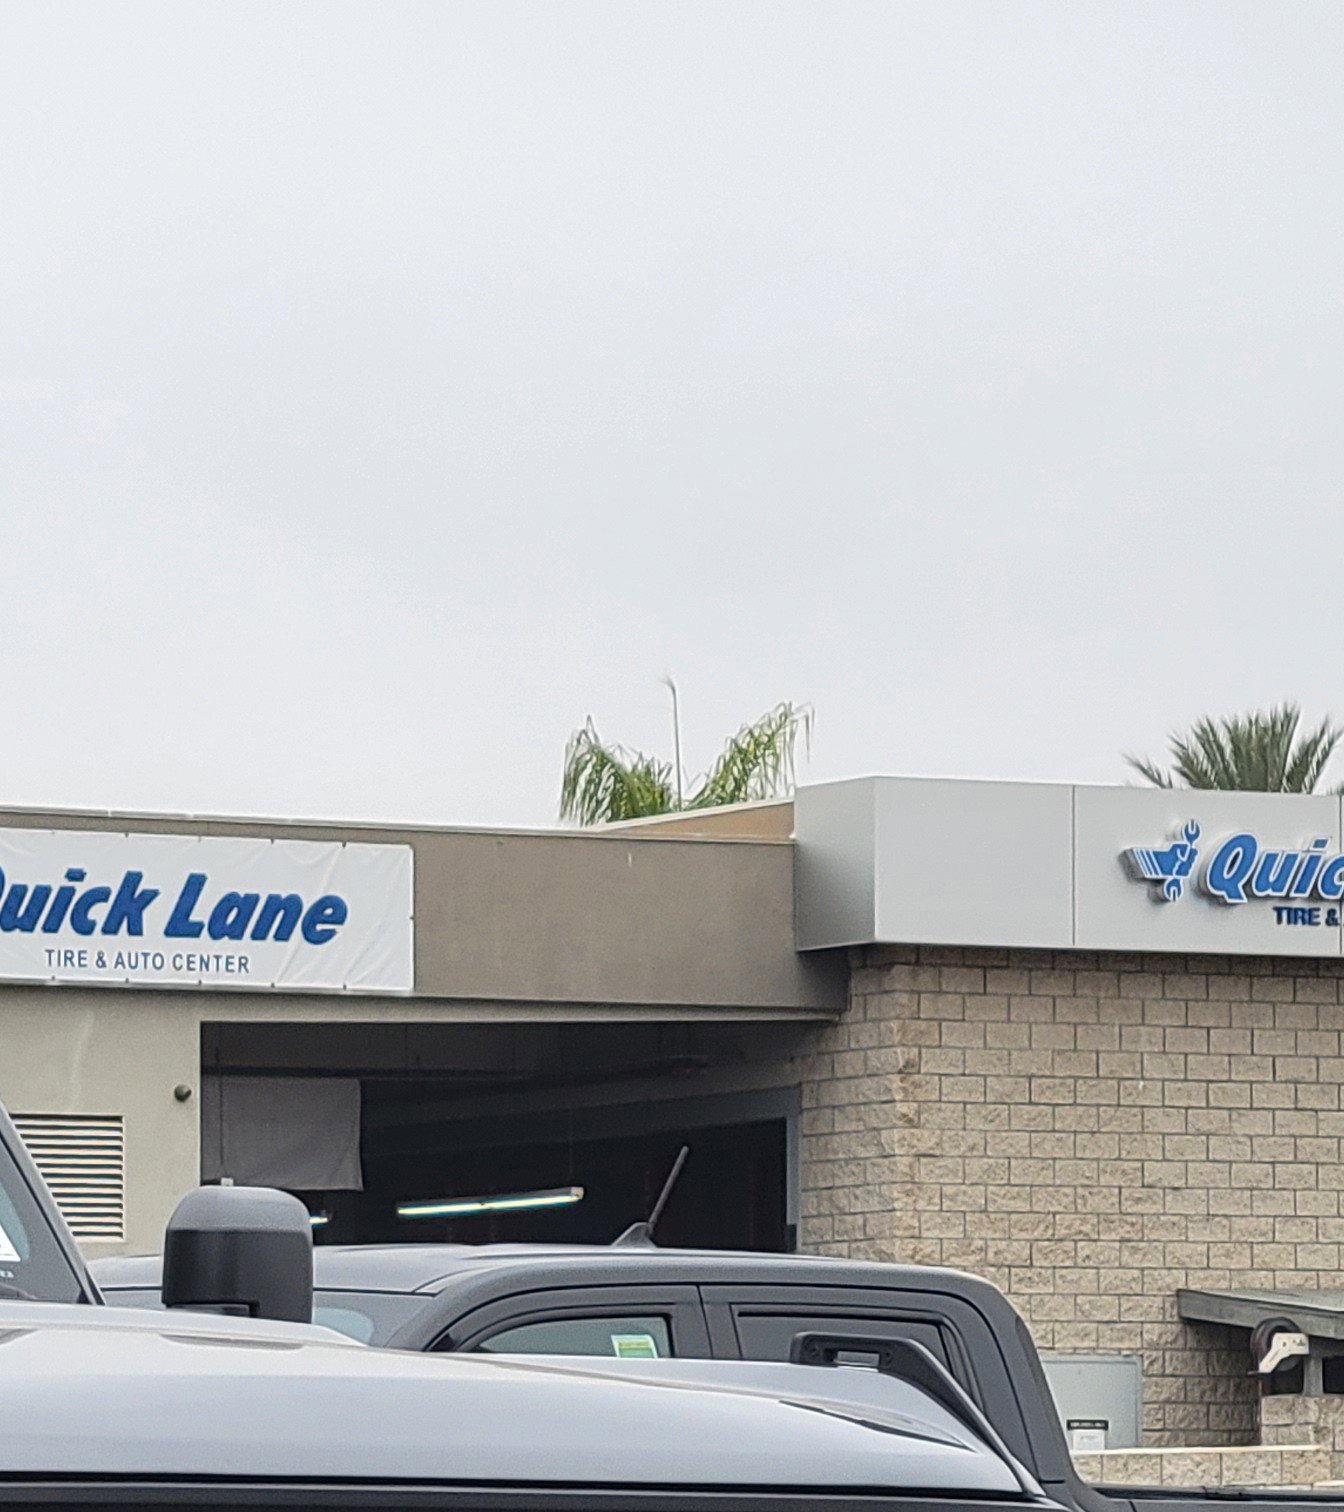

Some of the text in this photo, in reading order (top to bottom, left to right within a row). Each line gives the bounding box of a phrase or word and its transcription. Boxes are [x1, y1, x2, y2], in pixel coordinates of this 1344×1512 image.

[163, 872, 348, 945] Lane
[1273, 906, 1320, 926] TIRE
[45, 948, 250, 974] TIRE & AUTO CENTER
